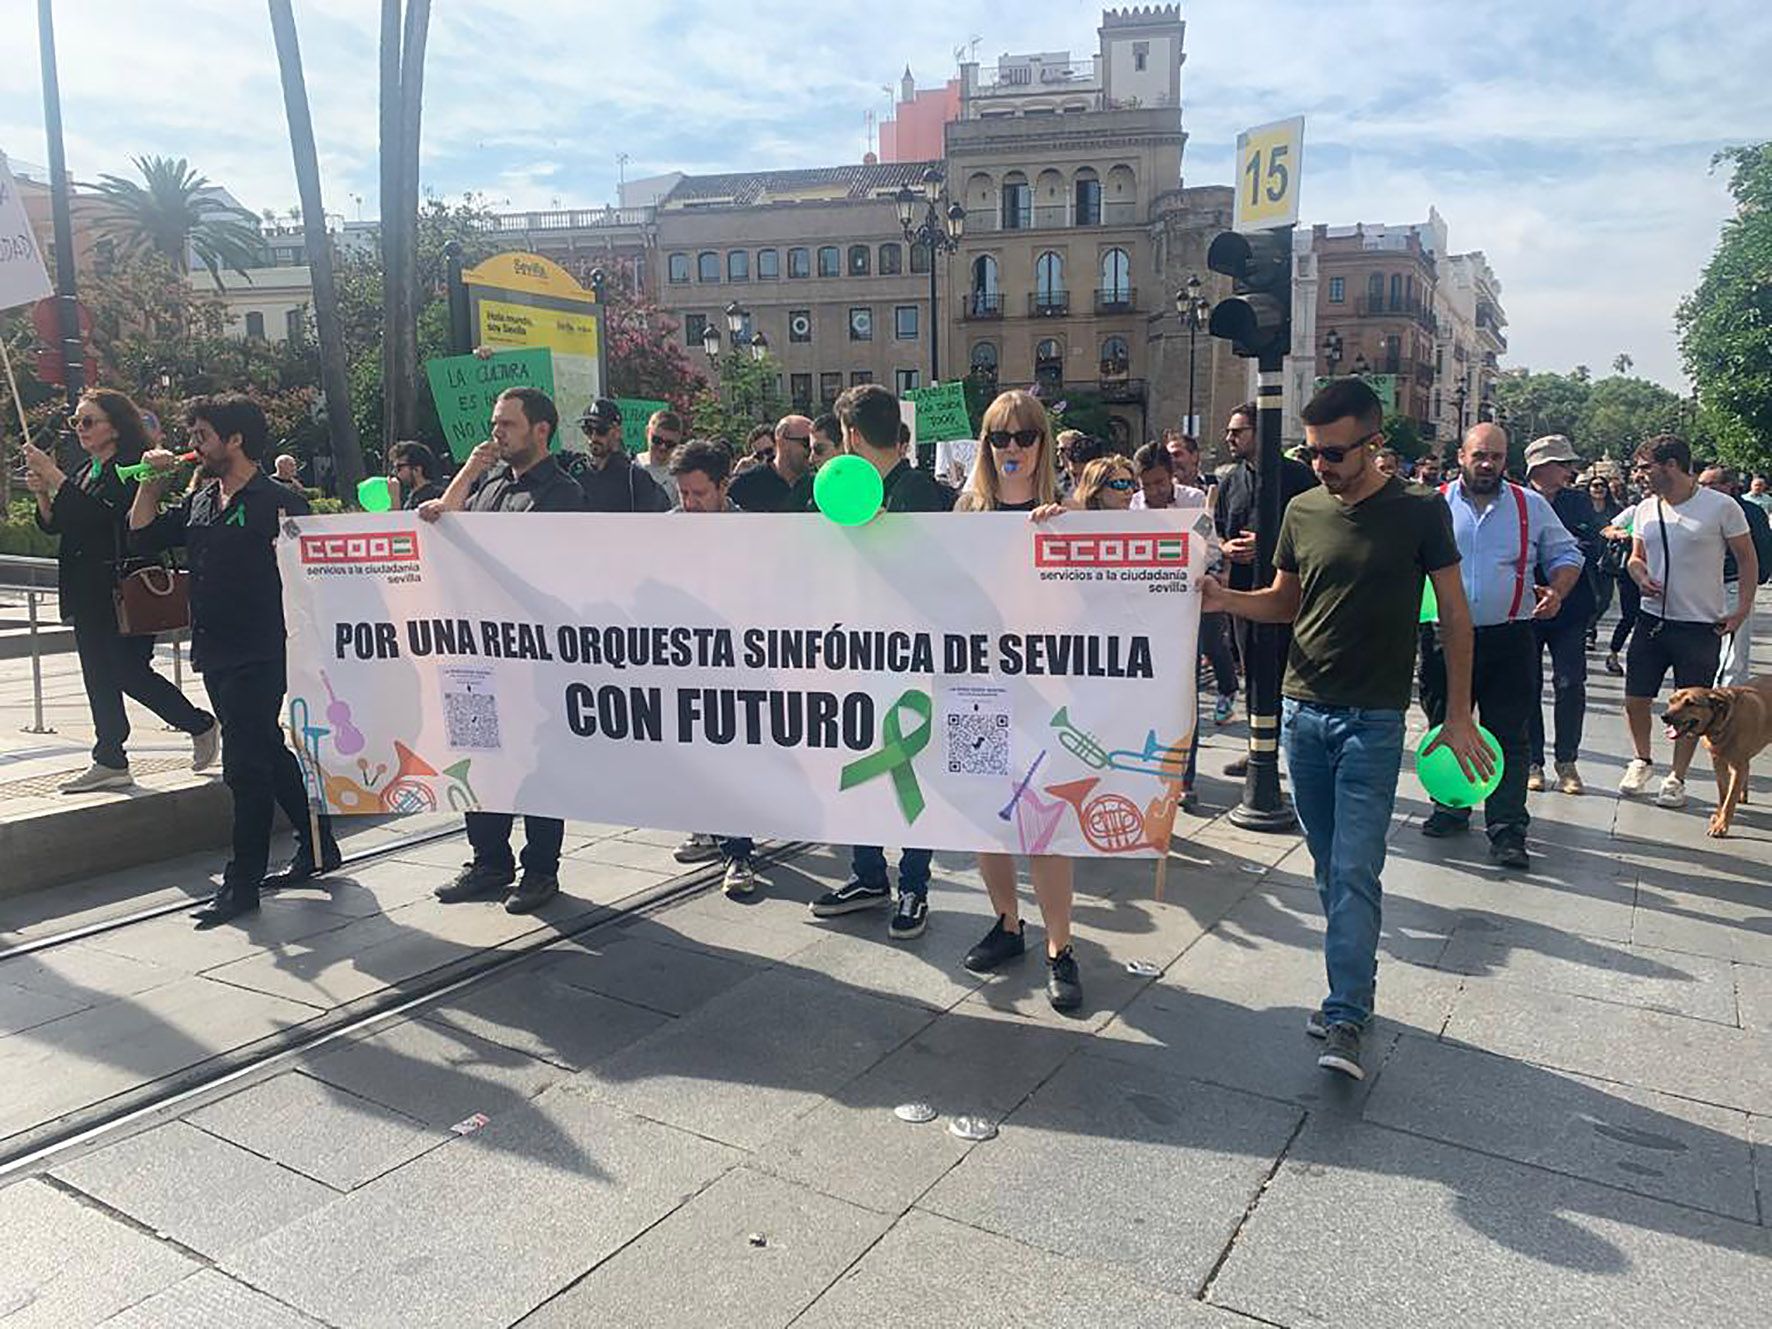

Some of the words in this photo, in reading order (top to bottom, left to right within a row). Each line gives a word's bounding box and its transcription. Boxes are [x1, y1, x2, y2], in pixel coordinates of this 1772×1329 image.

[1245, 145, 1289, 206] 15
[447, 368, 467, 388] LA
[459, 394, 477, 411] ES
[452, 421, 476, 440] NO
[1043, 540, 1153, 560] CCOO
[387, 574, 421, 584] sevilla
[1040, 569, 1093, 581] servicios
[1095, 572, 1104, 581] a
[1106, 569, 1118, 581] la
[1120, 569, 1188, 581] ciudadanía
[1148, 582, 1188, 593] sevilla
[335, 622, 400, 660] POR
[406, 619, 478, 657] UNA
[480, 620, 553, 661] REAL
[557, 625, 735, 669] ORQUESTA
[743, 623, 935, 674] SINFÓNICA
[943, 634, 990, 674] DE
[998, 634, 1154, 679] SEVILLA
[565, 682, 663, 742] CON
[677, 688, 876, 751] FUTURO
